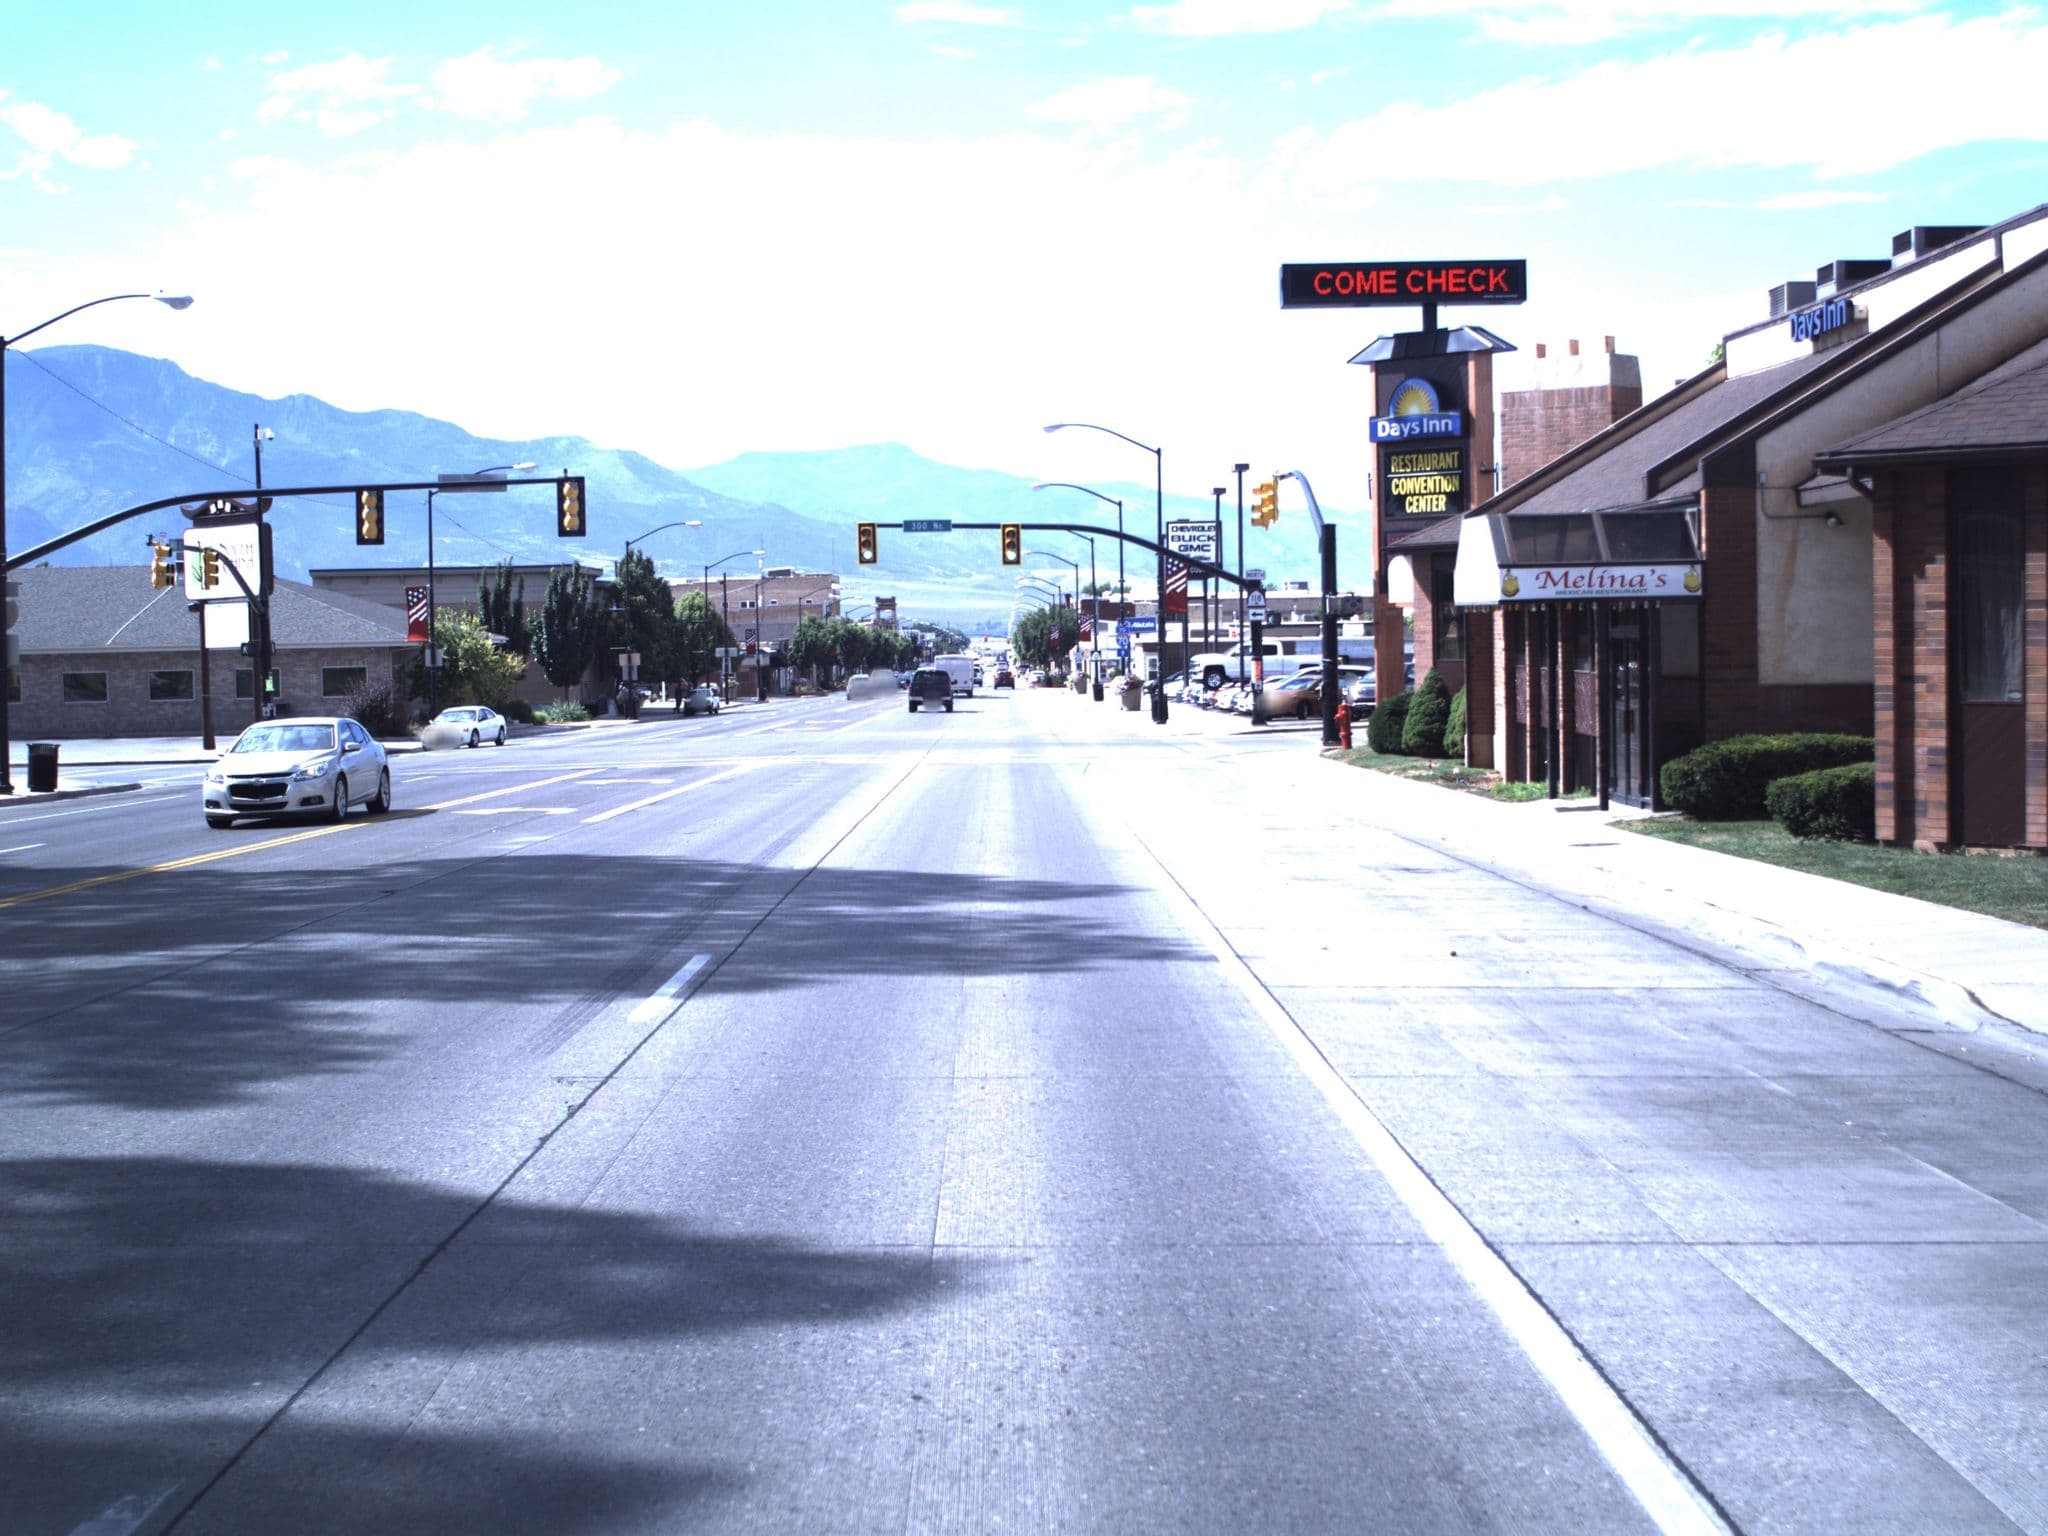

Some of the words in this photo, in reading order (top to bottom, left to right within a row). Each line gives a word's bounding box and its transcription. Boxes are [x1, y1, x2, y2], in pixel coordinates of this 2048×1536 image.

[1313, 270, 1398, 295] COME
[1405, 268, 1509, 293] CHECK
[1789, 309, 1821, 342] Days
[1823, 299, 1847, 332] Inn
[1376, 418, 1420, 438] Days
[1422, 416, 1453, 434] Inn
[1391, 451, 1460, 473] RESTAURANT
[1391, 475, 1460, 495] CONVENTION
[1404, 494, 1447, 514] CENTER
[1171, 534, 1216, 543] BUICK
[1178, 544, 1211, 553] GMC
[1555, 588, 1593, 596] MEXICAN
[1595, 587, 1648, 596] RESTAURANT
[1117, 636, 1128, 645] 70
